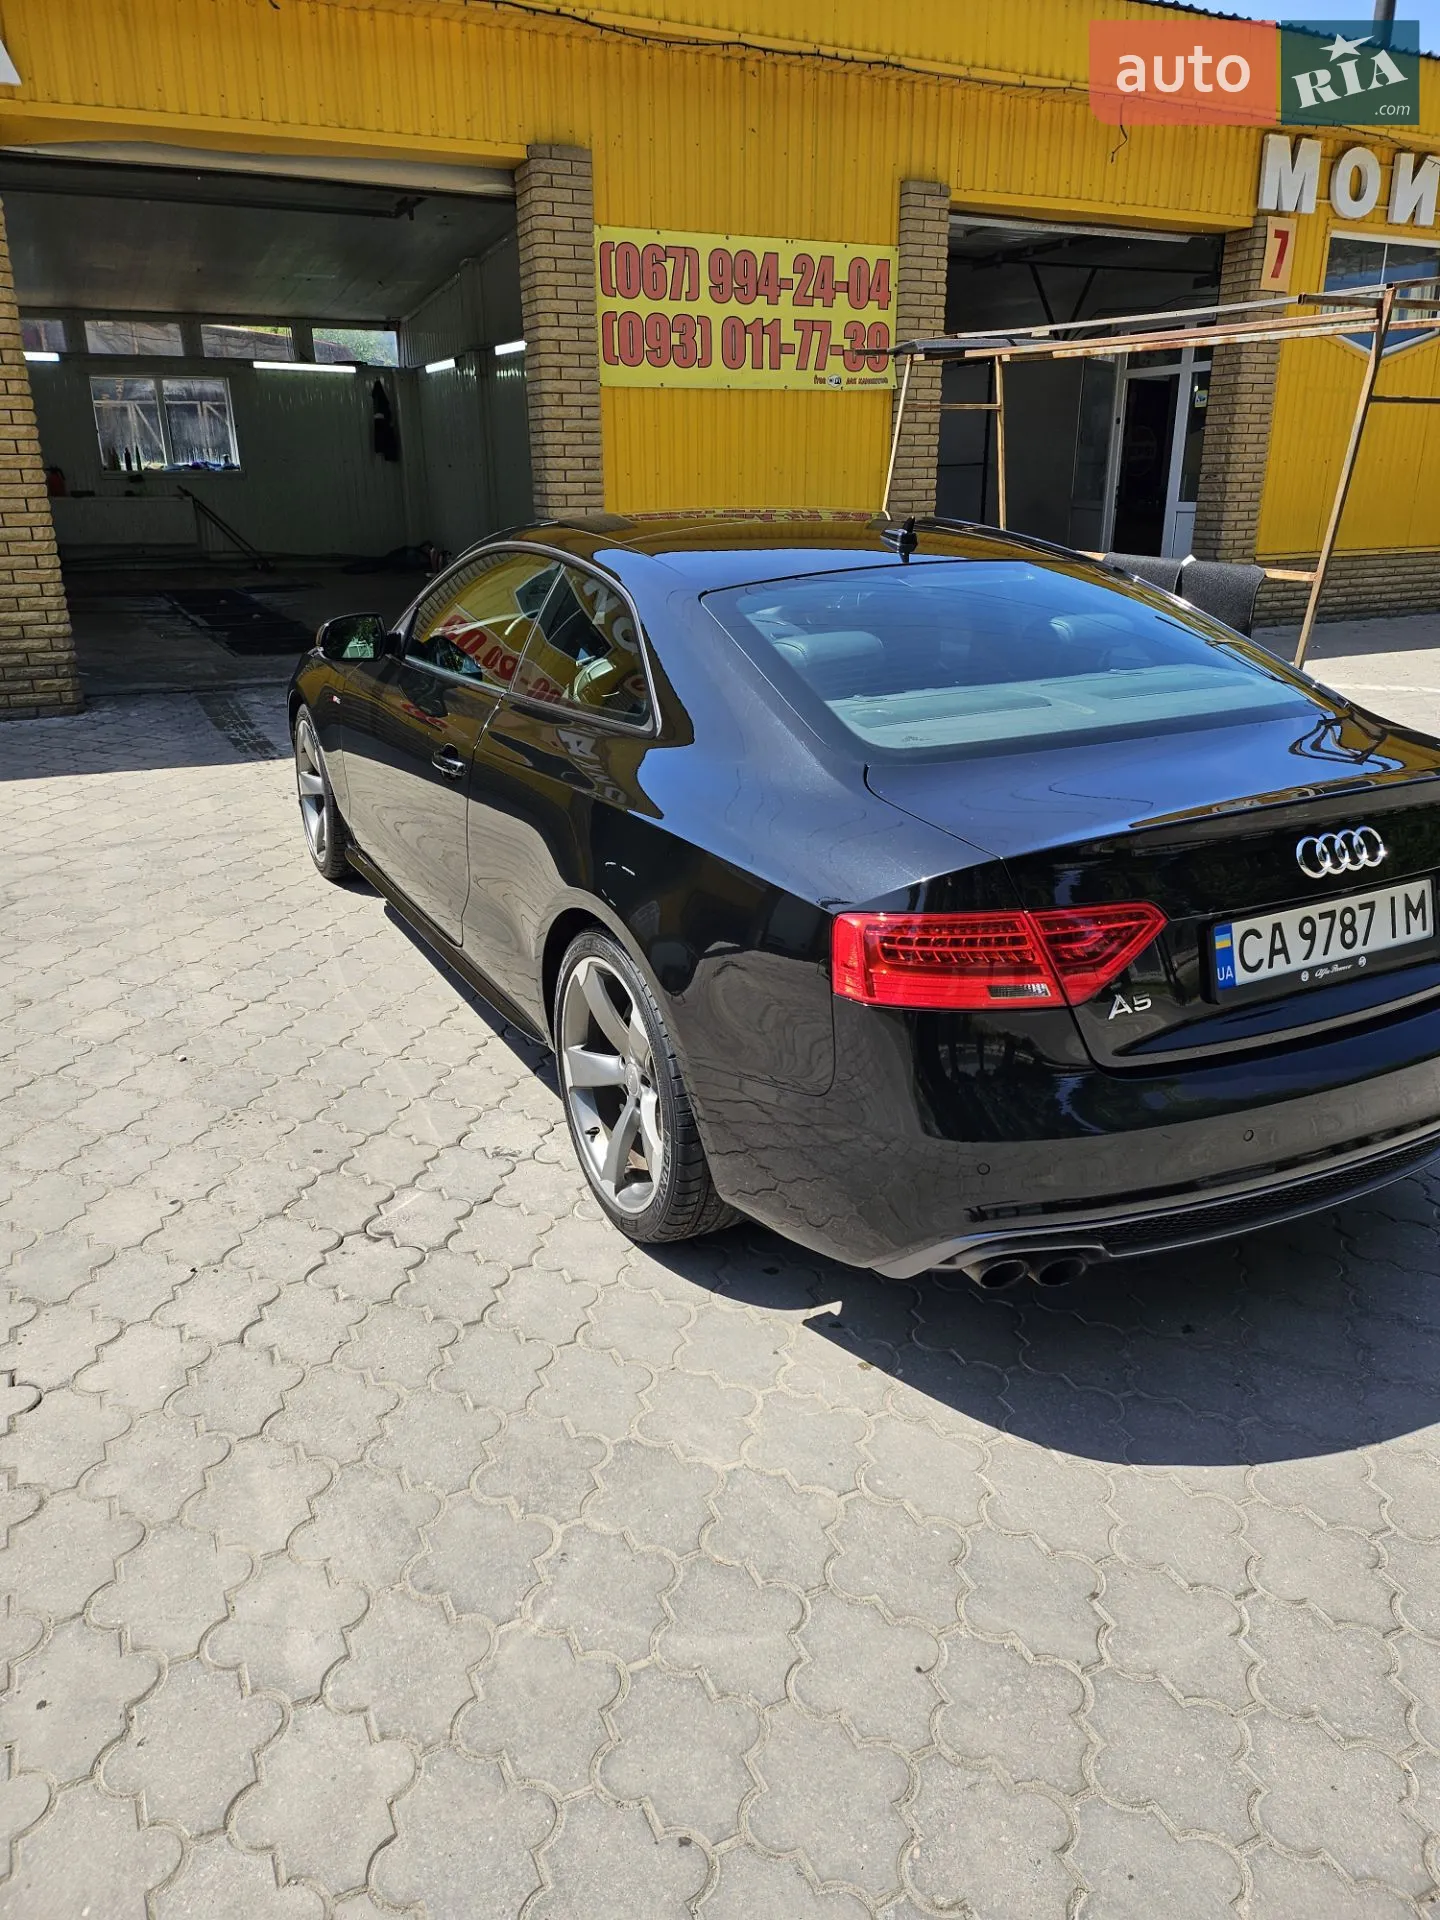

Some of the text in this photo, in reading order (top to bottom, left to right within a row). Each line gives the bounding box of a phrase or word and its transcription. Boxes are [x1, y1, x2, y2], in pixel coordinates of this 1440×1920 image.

[599, 241, 892, 310] (067) 994-24-04
[1270, 228, 1290, 279] 7
[601, 311, 890, 373] (093) 011-77-39
[1238, 889, 1428, 974] CA 9787 IM
[1217, 966, 1234, 981] UA
[1108, 993, 1152, 1020] A5
